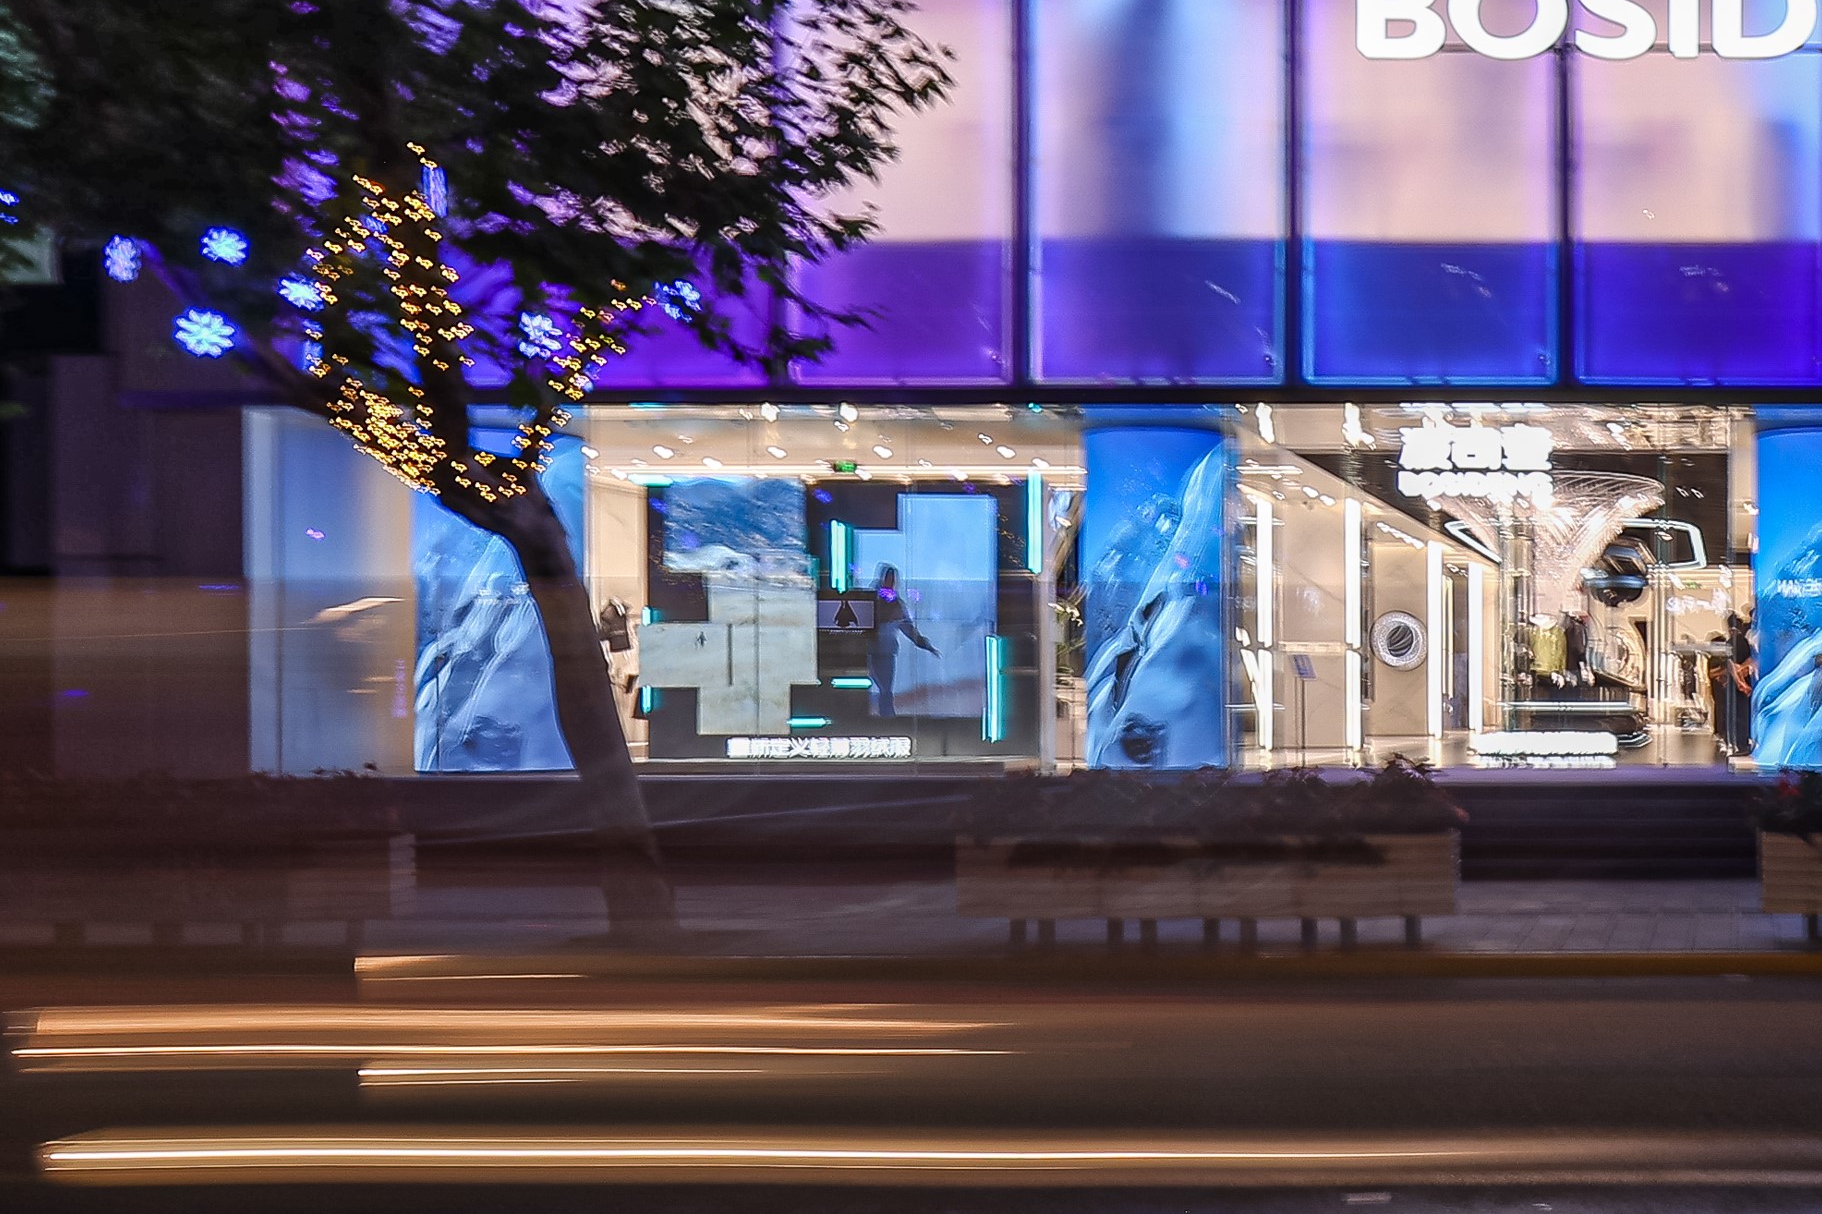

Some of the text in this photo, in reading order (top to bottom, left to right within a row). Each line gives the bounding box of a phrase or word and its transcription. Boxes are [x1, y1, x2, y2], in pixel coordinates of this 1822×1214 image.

[728, 737, 911, 758] 新定义轻羽绒服
